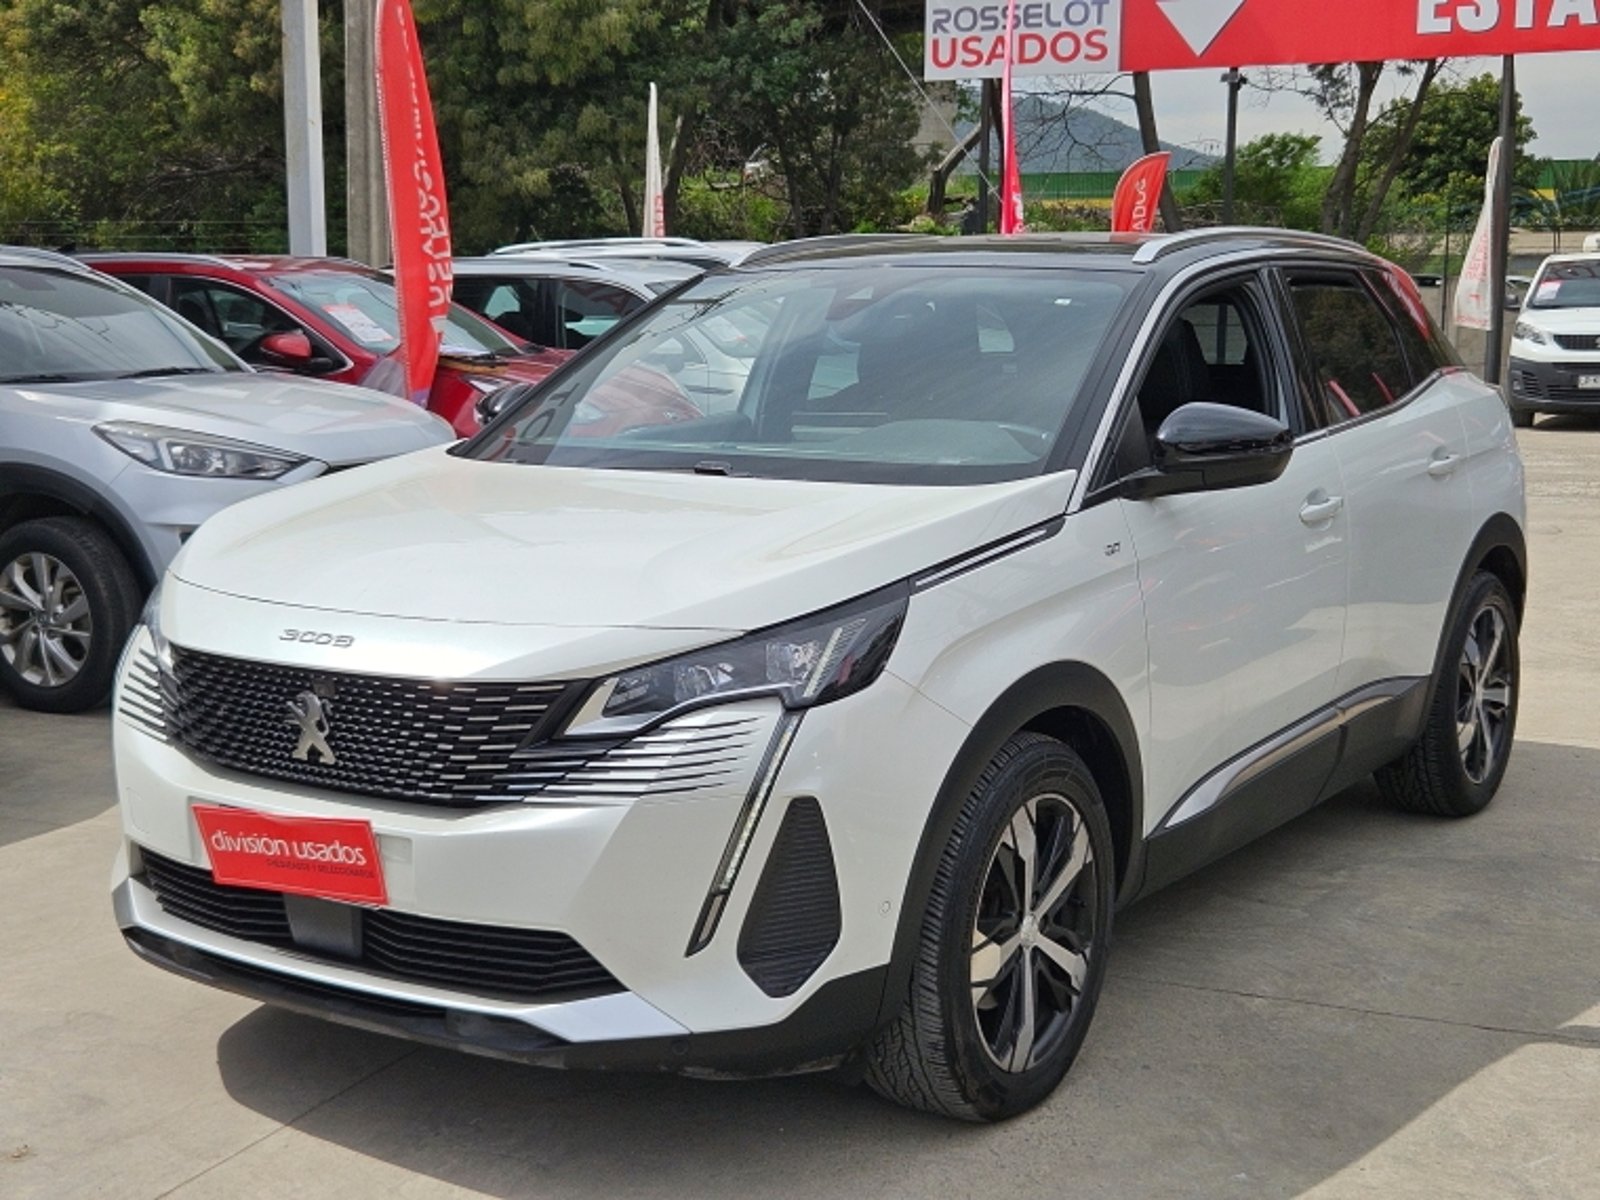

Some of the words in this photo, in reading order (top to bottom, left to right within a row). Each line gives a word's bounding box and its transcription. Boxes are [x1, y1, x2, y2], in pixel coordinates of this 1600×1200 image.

[931, 1, 1109, 34] ROSSELOT
[931, 29, 1109, 69] USADOS
[278, 628, 355, 648] 3008
[211, 829, 291, 857] división
[293, 840, 367, 865] usados
